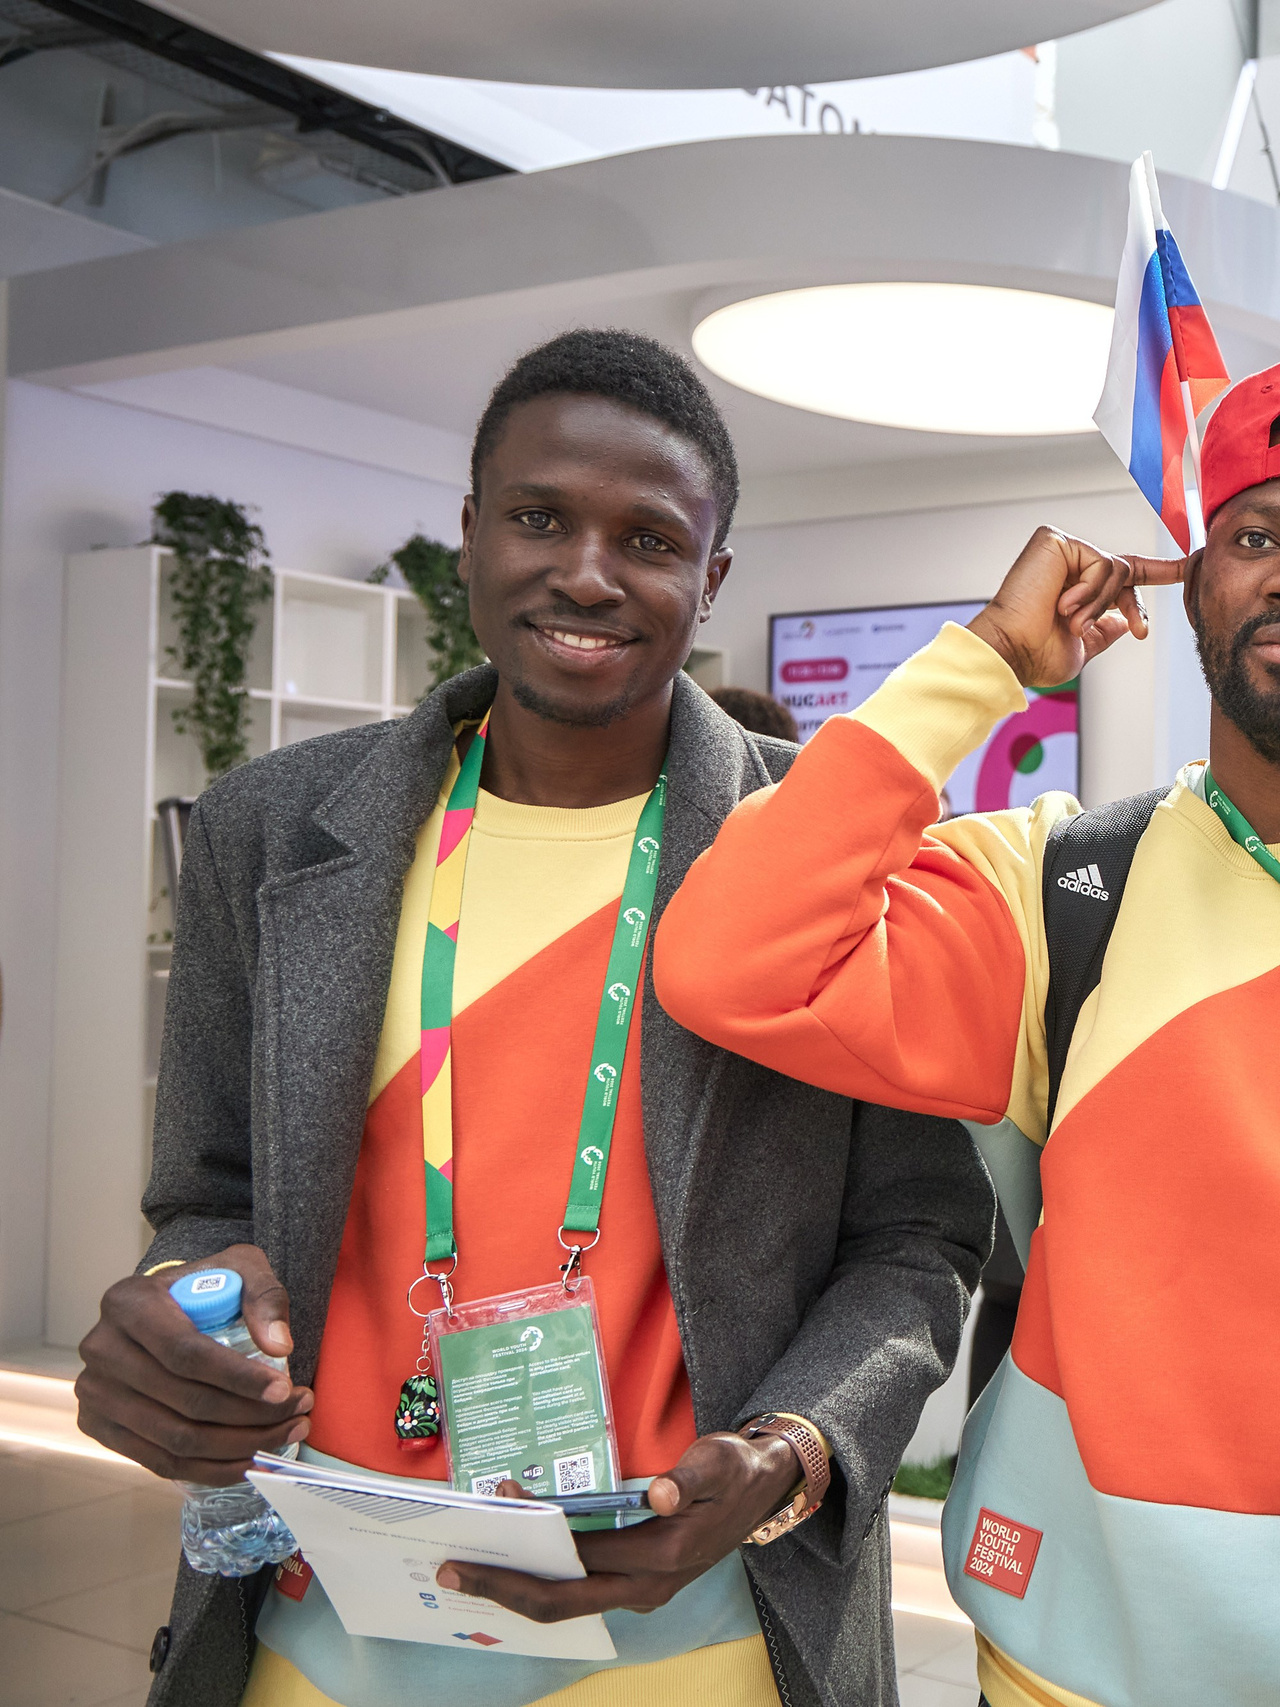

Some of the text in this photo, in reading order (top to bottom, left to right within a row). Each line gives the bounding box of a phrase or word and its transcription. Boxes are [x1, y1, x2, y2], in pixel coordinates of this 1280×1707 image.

[1057, 877, 1110, 901] adidas
[492, 1350, 515, 1358] FESTIVAL
[982, 1517, 1021, 1543] WORLD
[979, 1530, 1015, 1556] YOUTH
[970, 1557, 994, 1577] 2024
[974, 1543, 1023, 1575] FESTIVAL
